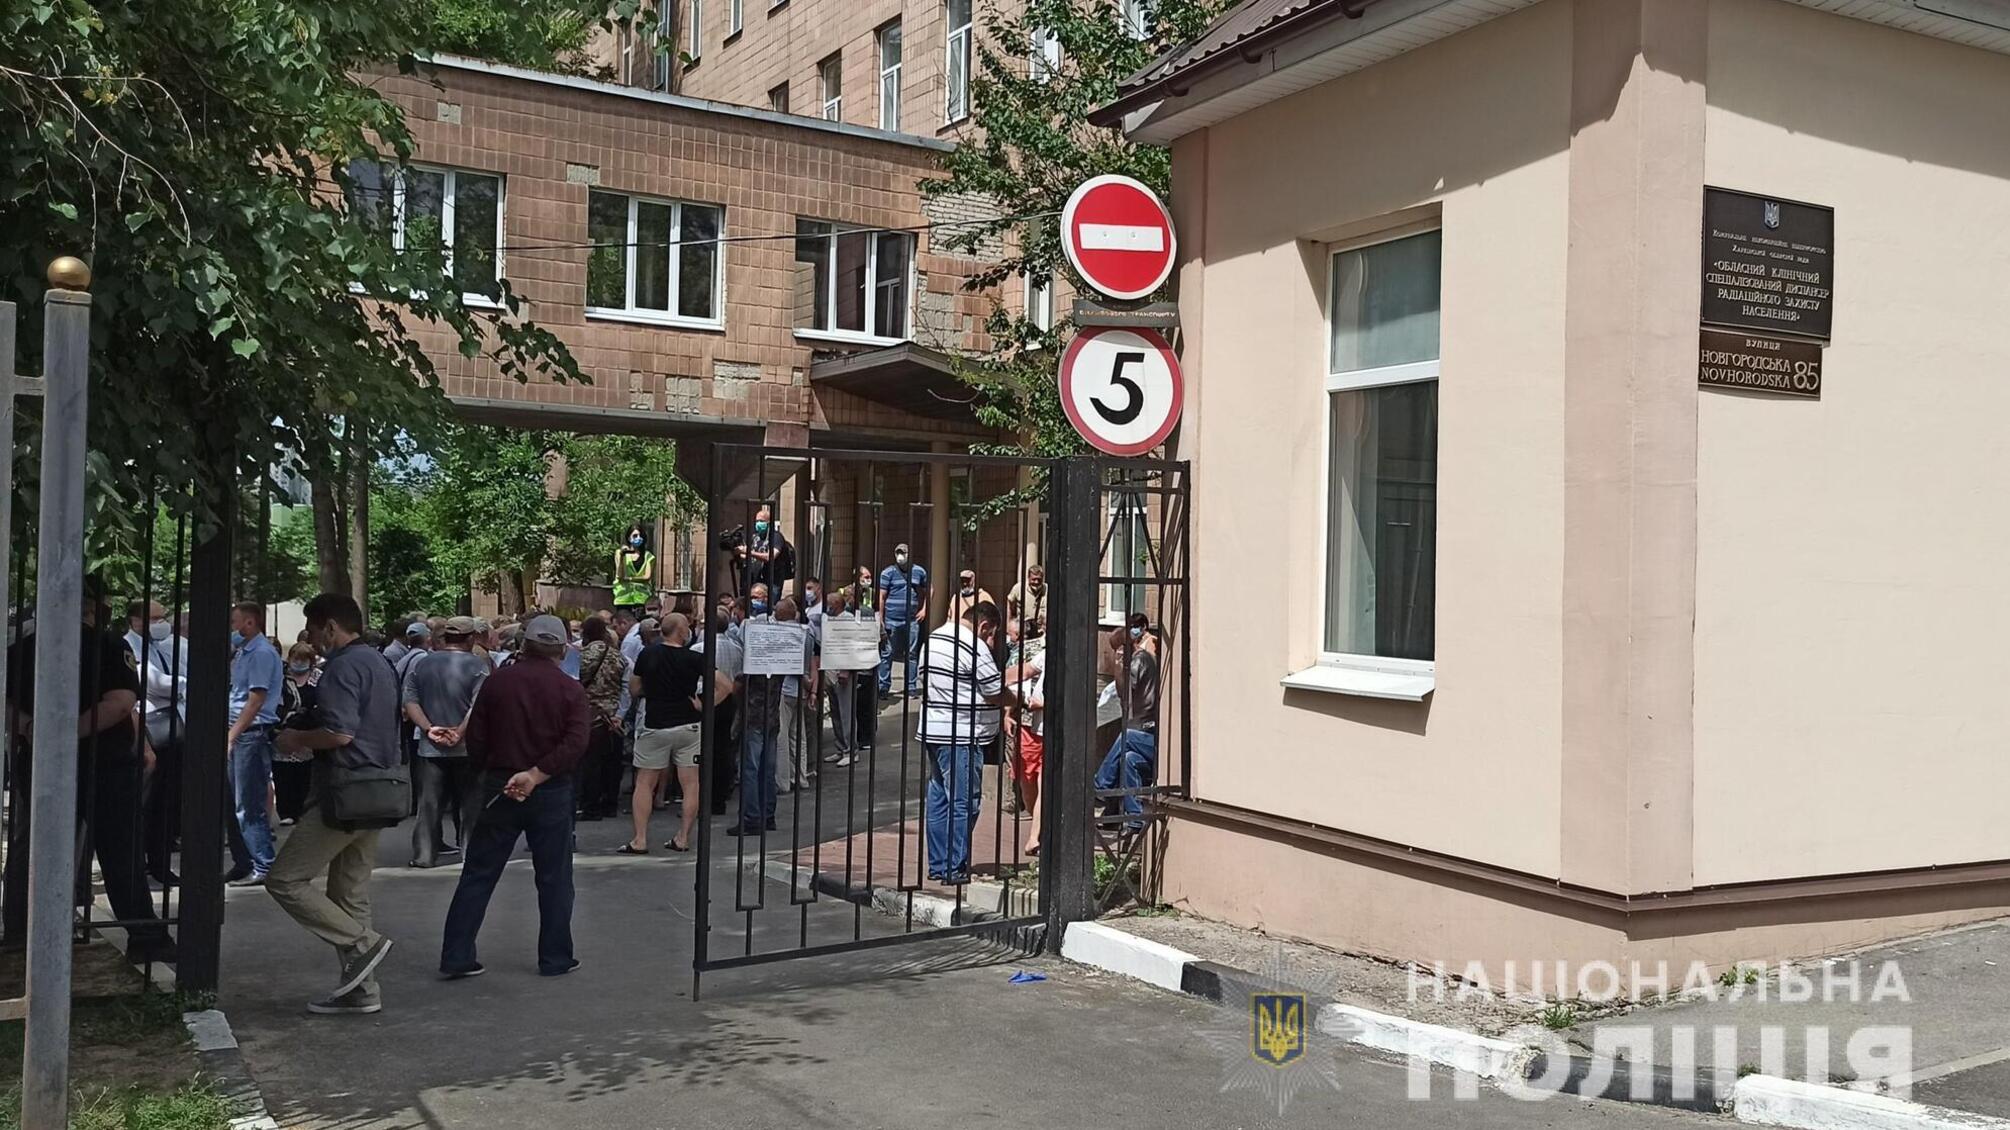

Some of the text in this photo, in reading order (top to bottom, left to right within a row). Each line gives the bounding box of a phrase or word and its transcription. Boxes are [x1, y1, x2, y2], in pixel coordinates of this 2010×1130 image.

[1700, 349, 1791, 373] НОВГОРОДСЬКА
[1089, 352, 1145, 426] 5
[1700, 366, 1791, 389] NOVHORODSKA
[1793, 361, 1819, 391] 85
